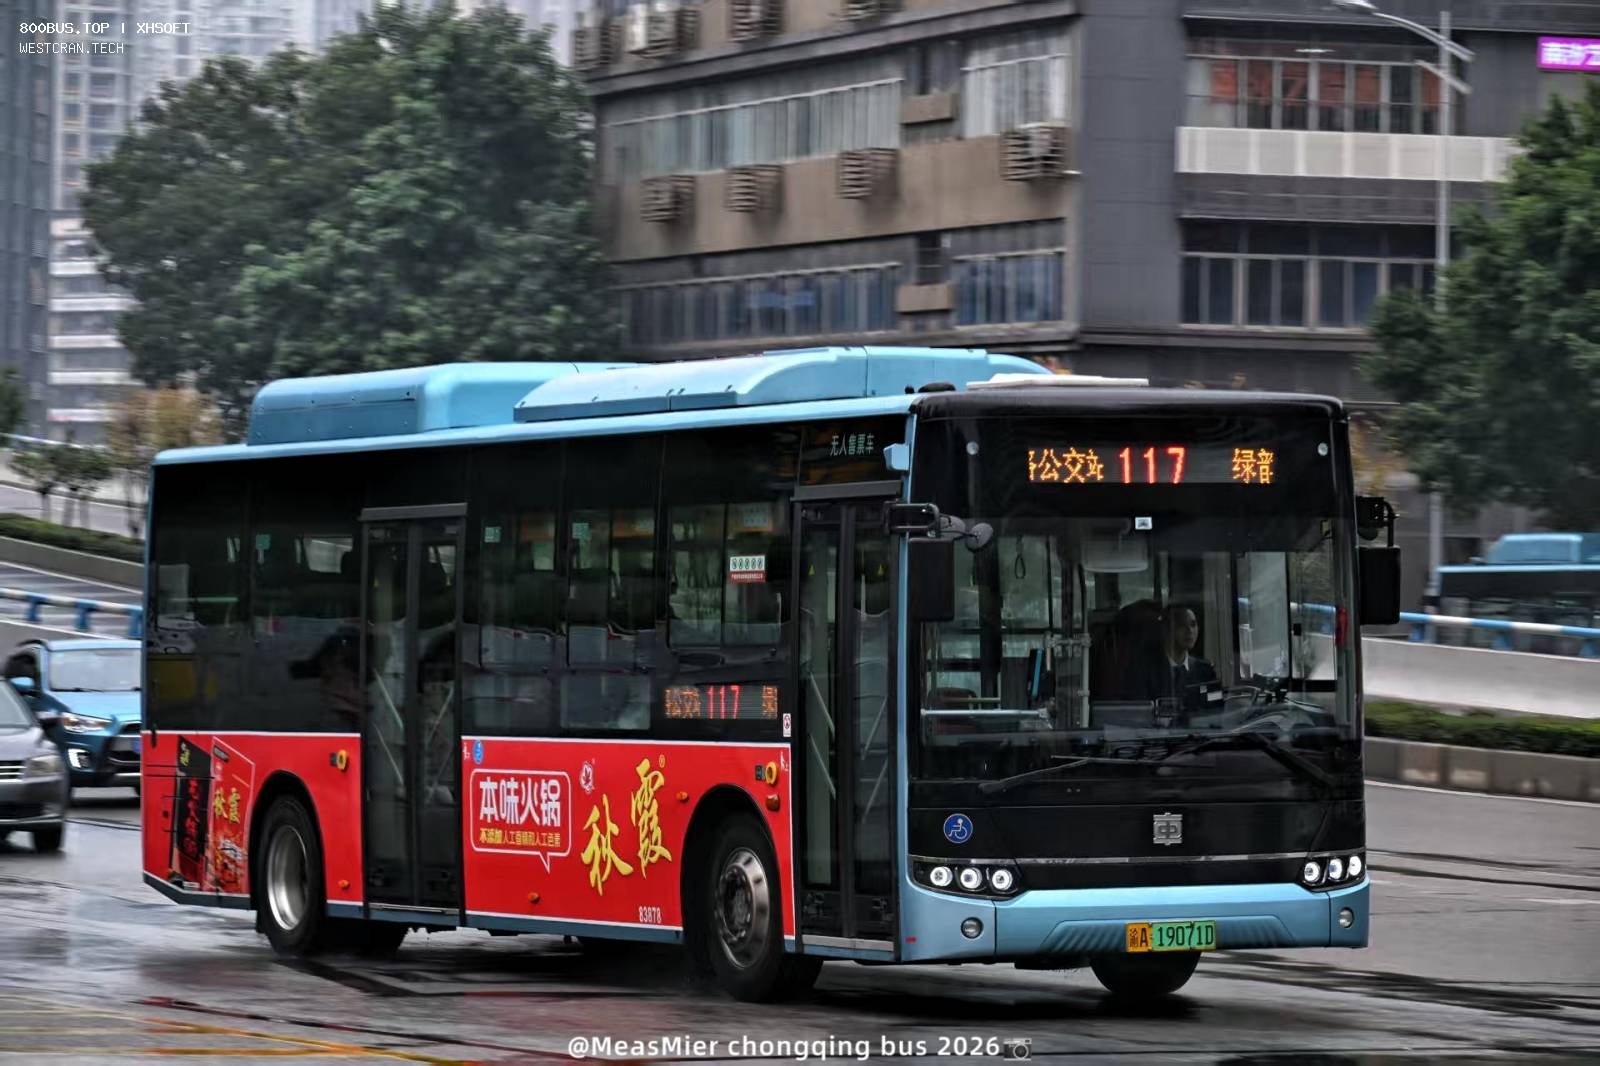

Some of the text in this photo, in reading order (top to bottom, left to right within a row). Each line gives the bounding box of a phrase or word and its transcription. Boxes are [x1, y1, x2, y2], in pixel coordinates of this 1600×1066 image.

[830, 434, 874, 456] 无人售票车
[1119, 447, 1186, 484] 117
[707, 685, 741, 719] 117
[479, 776, 561, 827] 本味火锅
[638, 906, 662, 924] 83878
